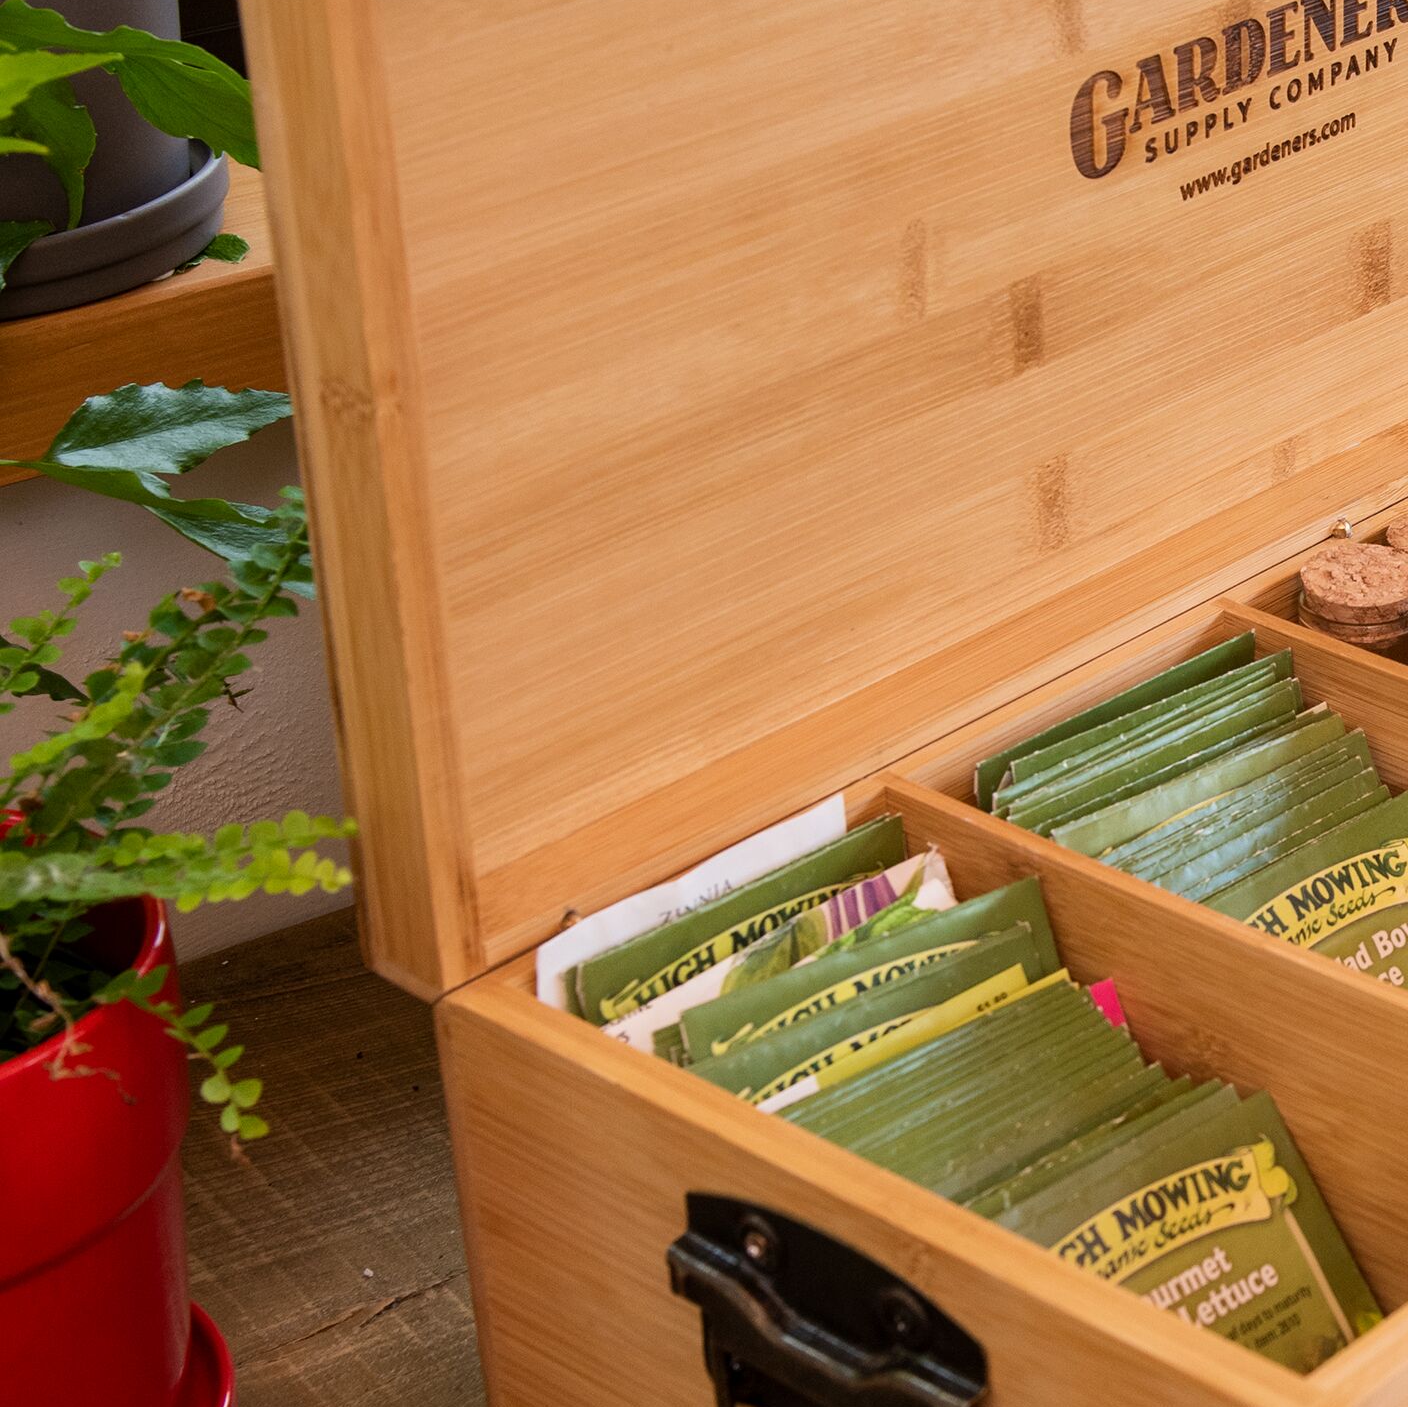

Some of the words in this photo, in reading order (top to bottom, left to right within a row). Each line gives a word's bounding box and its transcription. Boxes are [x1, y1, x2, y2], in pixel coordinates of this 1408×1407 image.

[1145, 97, 1253, 164] SUPPLY
[1269, 38, 1398, 110] COMPANY
[1179, 110, 1357, 202] www.gardeners.com
[1286, 849, 1408, 922] MOWING
[1112, 1158, 1251, 1243] MOWING
[1143, 1246, 1233, 1310] urmet
